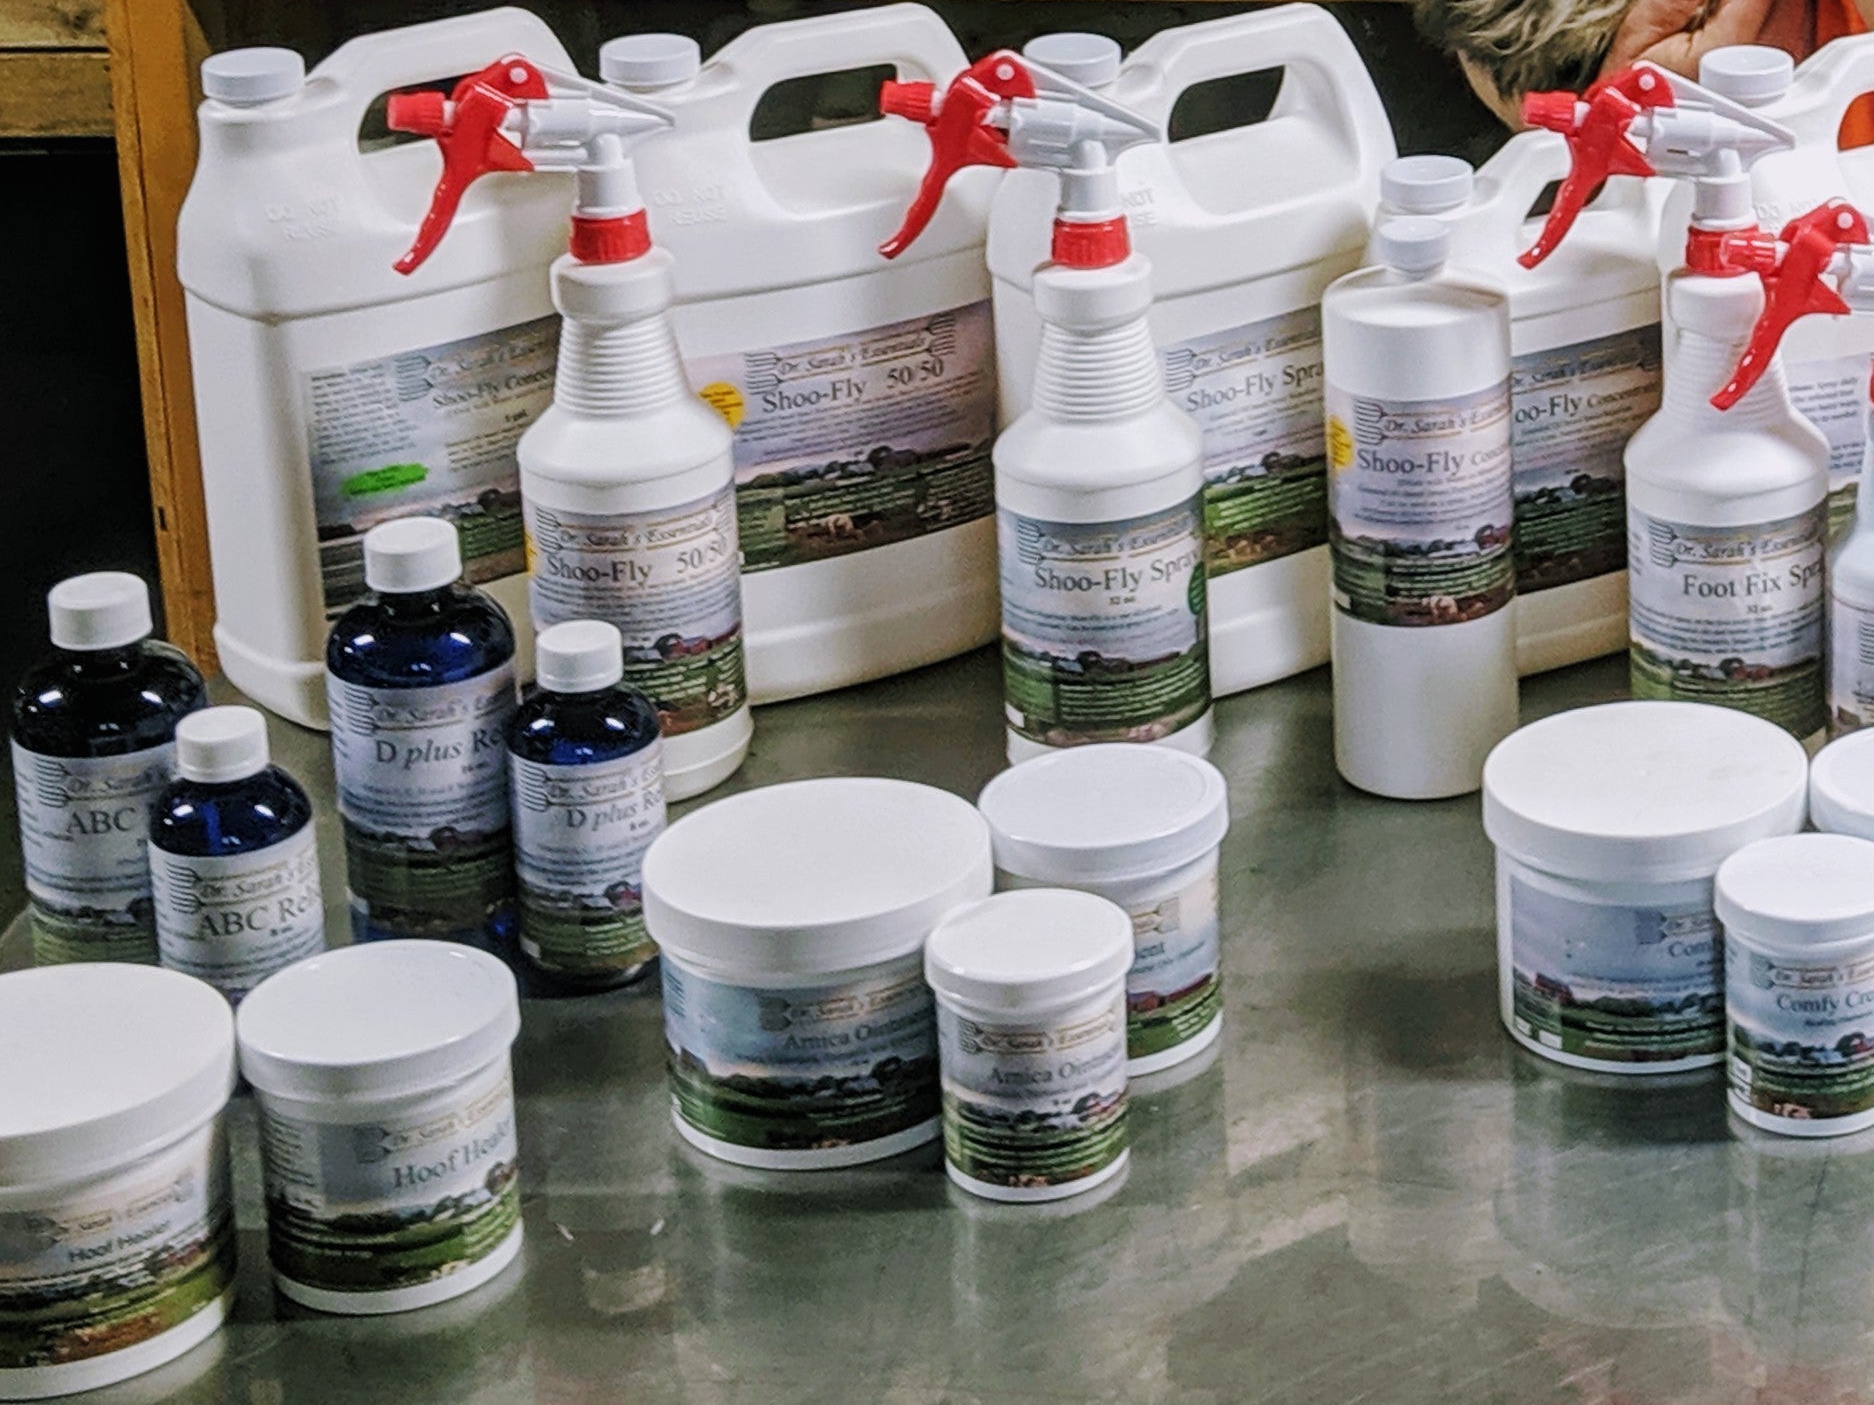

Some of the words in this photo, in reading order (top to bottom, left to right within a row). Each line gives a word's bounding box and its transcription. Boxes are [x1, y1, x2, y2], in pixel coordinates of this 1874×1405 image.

[762, 378, 868, 414] Shoo-Fly
[1186, 373, 1277, 414] Shoo-Fly
[1281, 360, 1323, 388] Spra
[1515, 392, 1584, 425] oo-Fly
[1356, 449, 1465, 477] Shoo-Fly
[1676, 542, 1697, 557] Dr.
[1700, 541, 1757, 559] Sarah's
[547, 556, 654, 588] Shoo-Fly
[1034, 566, 1144, 593] Shoo-Fly
[1151, 549, 1200, 583] Spray
[1682, 573, 1737, 598] Foot
[1745, 571, 1782, 596] Fix
[376, 740, 397, 763] D
[405, 735, 461, 770] plus
[65, 806, 137, 836] ABC
[566, 809, 587, 829] D
[593, 801, 637, 832] plus
[203, 907, 270, 937] ABC
[1777, 993, 1840, 1016] Comfy
[990, 1068, 1053, 1085] Arnica
[393, 1147, 459, 1188] Hoof
